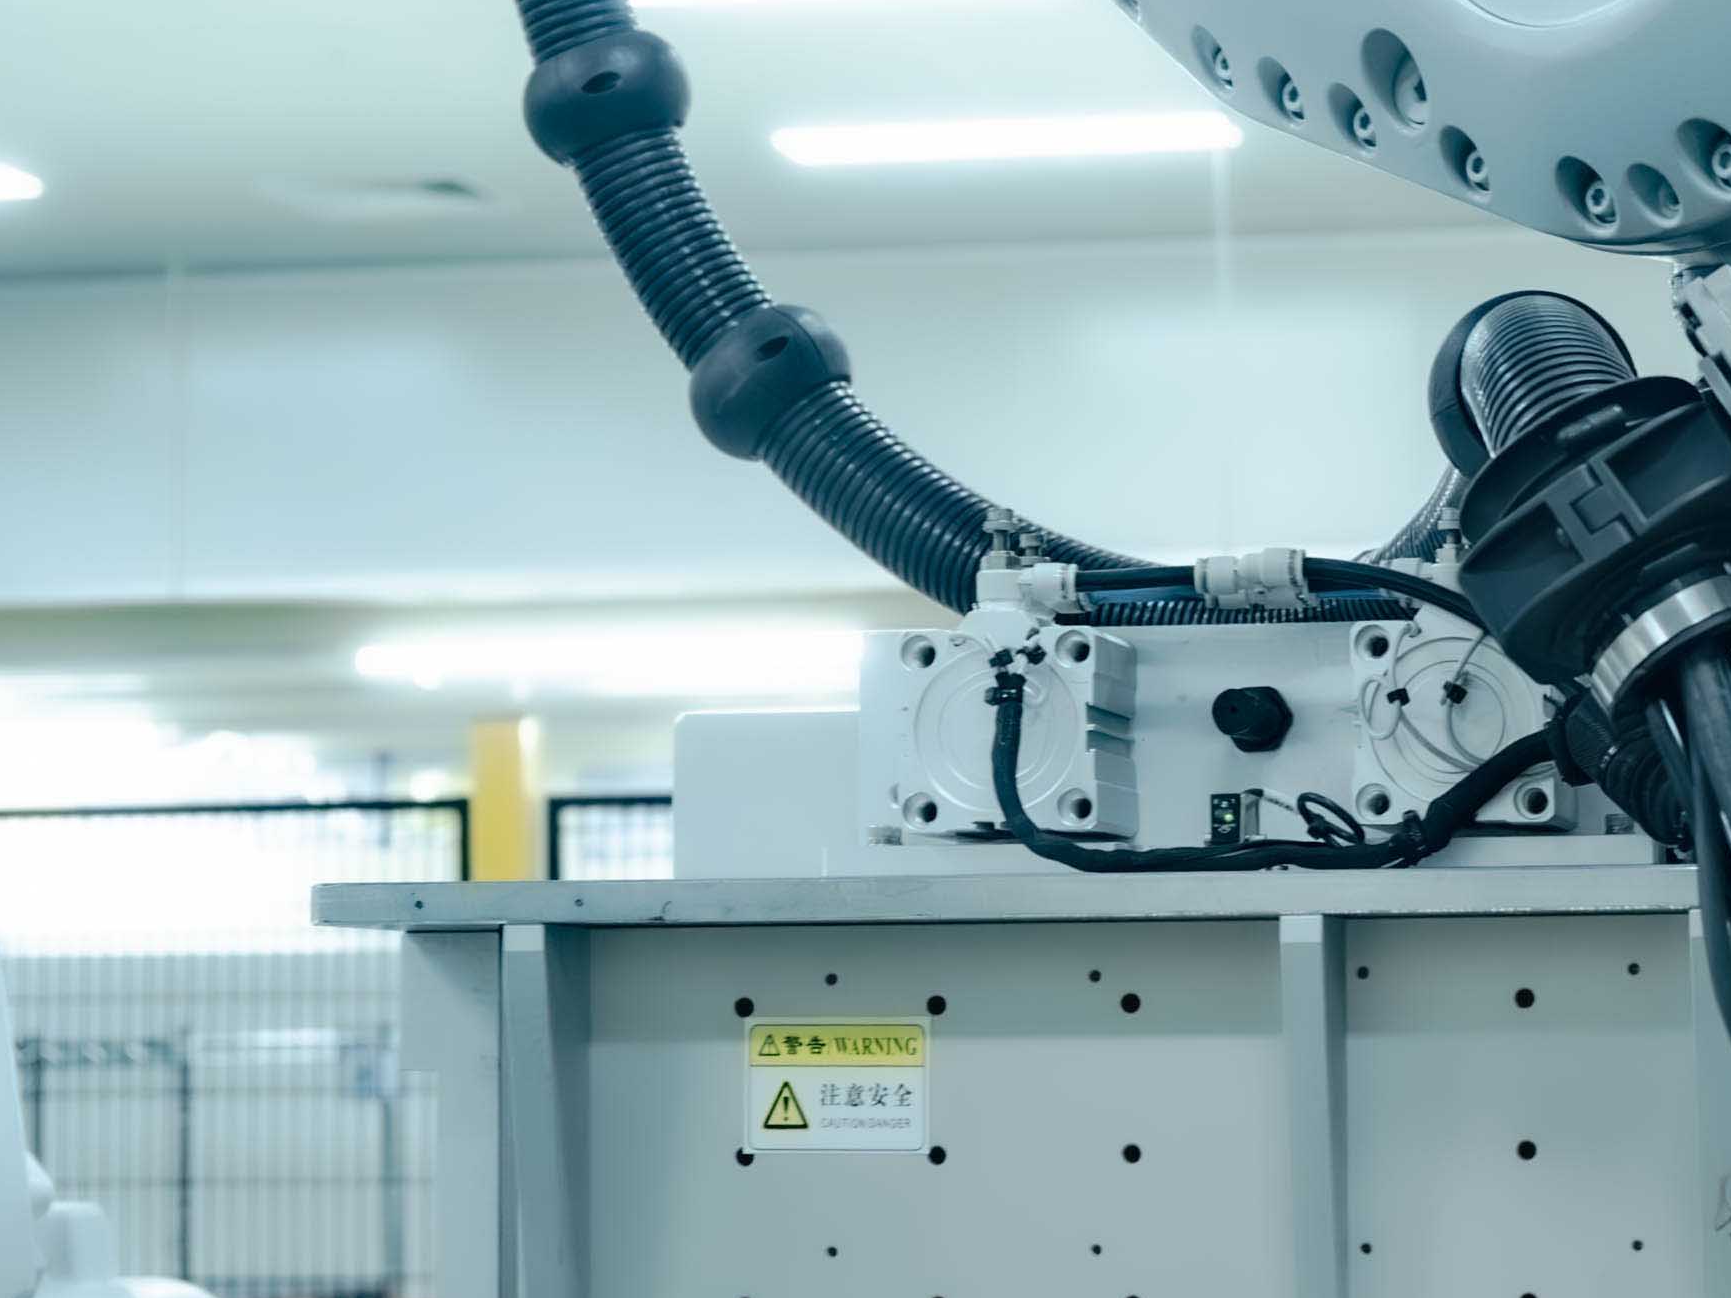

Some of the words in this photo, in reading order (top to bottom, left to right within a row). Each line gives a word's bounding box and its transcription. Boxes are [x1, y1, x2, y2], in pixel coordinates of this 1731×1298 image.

[782, 1034, 827, 1056] 警告
[834, 1037, 918, 1056] WARNING
[820, 1082, 914, 1107] 注意安全
